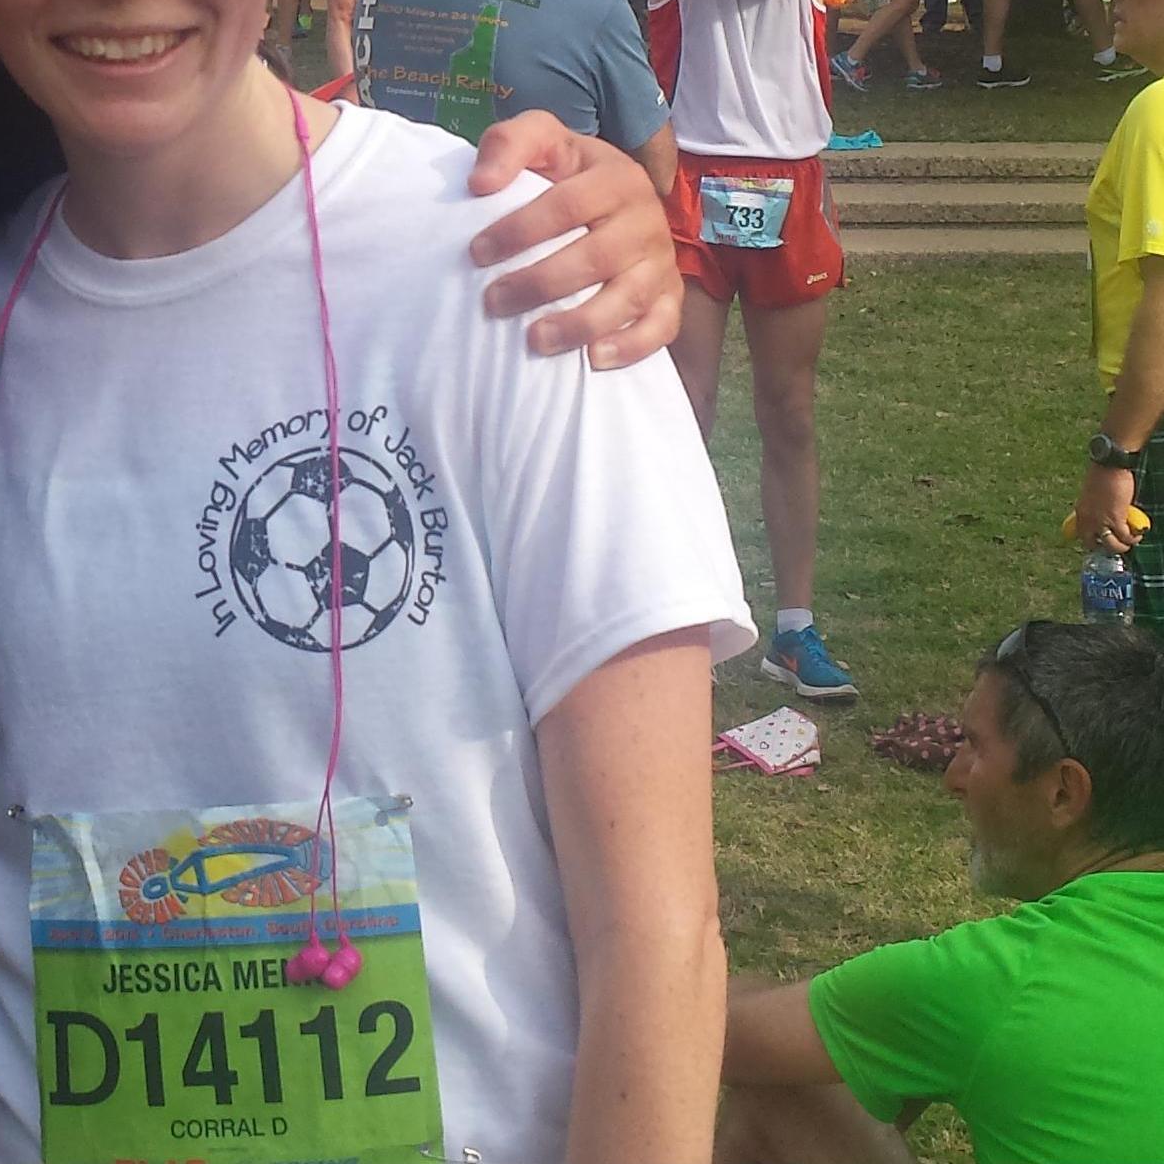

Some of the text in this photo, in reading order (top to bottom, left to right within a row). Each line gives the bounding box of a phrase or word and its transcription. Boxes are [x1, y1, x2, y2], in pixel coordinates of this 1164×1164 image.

[451, 11, 468, 21] 24
[393, 65, 451, 87] Beach
[456, 73, 515, 100] Relay
[725, 204, 765, 229] 733
[195, 404, 449, 638] In Loving Memory of Jack Burton
[102, 961, 223, 994] JESSICA
[46, 999, 422, 1108] D14112
[169, 1116, 289, 1139] CORRAL D
